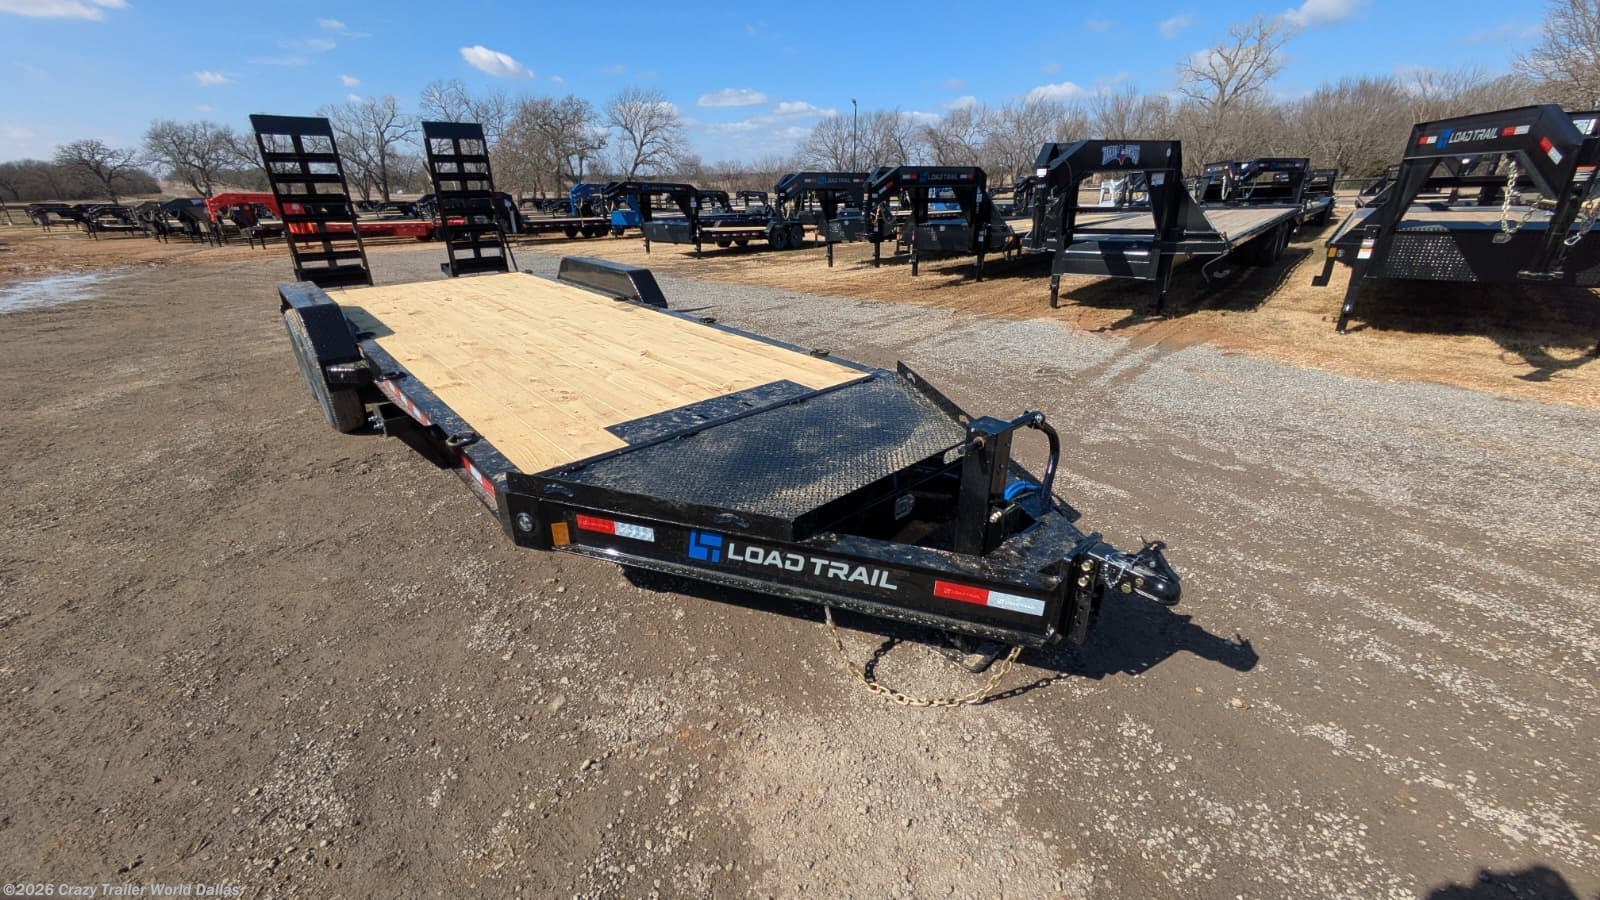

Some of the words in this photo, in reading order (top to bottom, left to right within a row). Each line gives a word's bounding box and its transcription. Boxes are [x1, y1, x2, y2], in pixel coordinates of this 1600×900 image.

[1448, 130, 1473, 144] LOAD
[1472, 127, 1499, 141] TRAIL
[727, 542, 805, 572] LOAD
[809, 556, 898, 591] TRAIL
